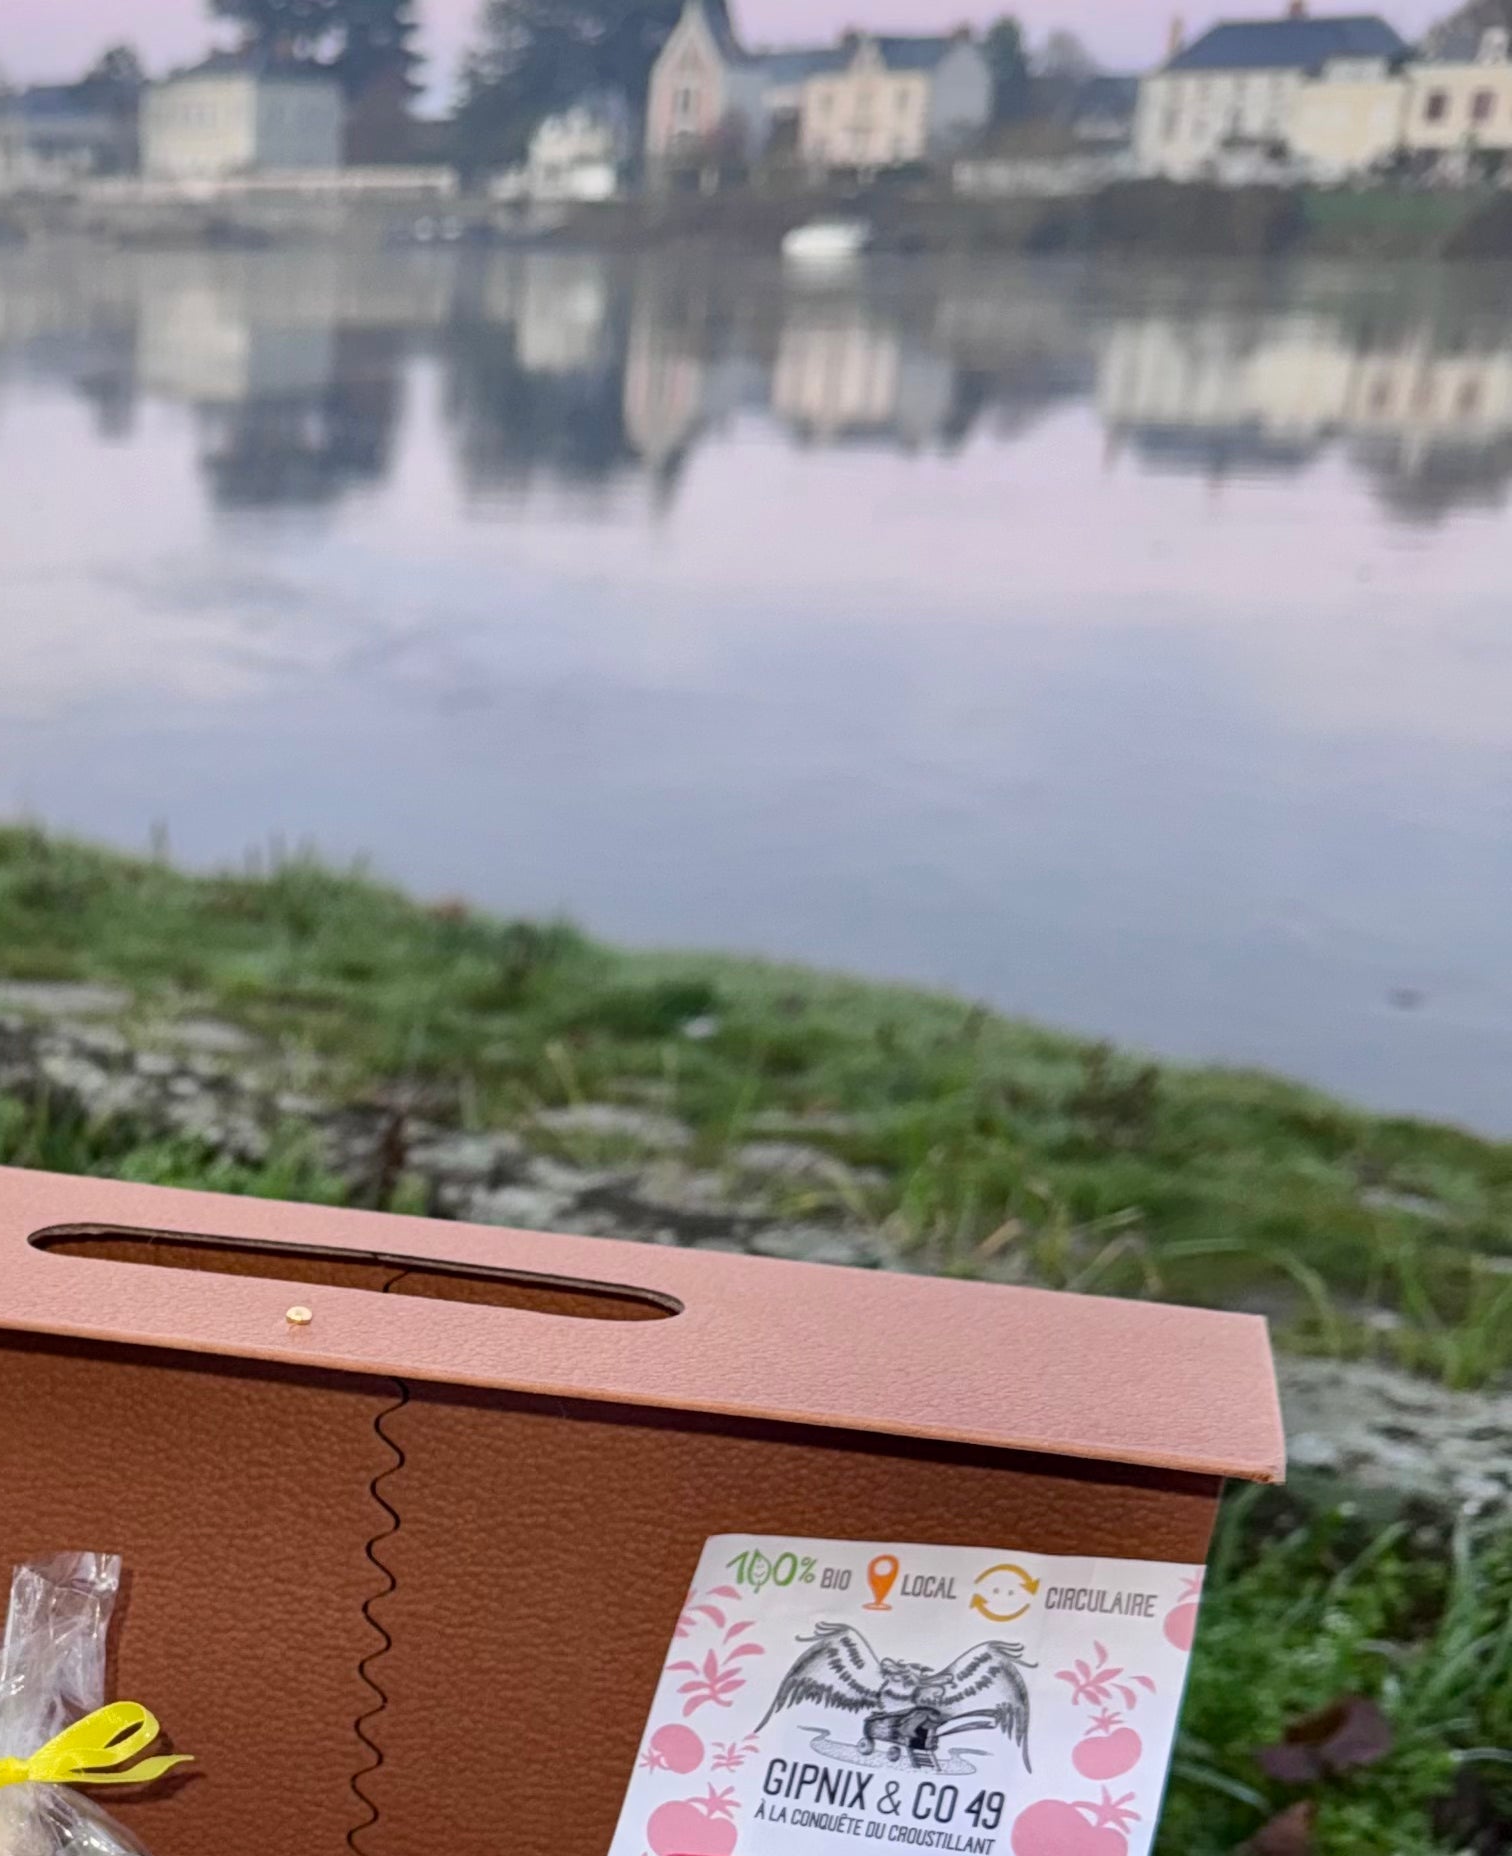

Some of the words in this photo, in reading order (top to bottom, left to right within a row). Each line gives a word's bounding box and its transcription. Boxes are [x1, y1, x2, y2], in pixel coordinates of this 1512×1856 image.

[726, 1549, 816, 1592] 100%
[820, 1566, 853, 1590] BIO
[900, 1573, 958, 1600] LOCAL
[1044, 1586, 1158, 1618] CIRCULAIRE
[763, 1758, 874, 1811] GIPNIX
[876, 1780, 902, 1816] &
[912, 1781, 959, 1824] CO
[965, 1789, 1006, 1830] 49
[754, 1799, 767, 1819] À
[768, 1805, 788, 1824] LA
[791, 1808, 864, 1837] CONQUÊTE
[865, 1821, 887, 1840] DU
[888, 1824, 996, 1856] CROUSTILLANT
